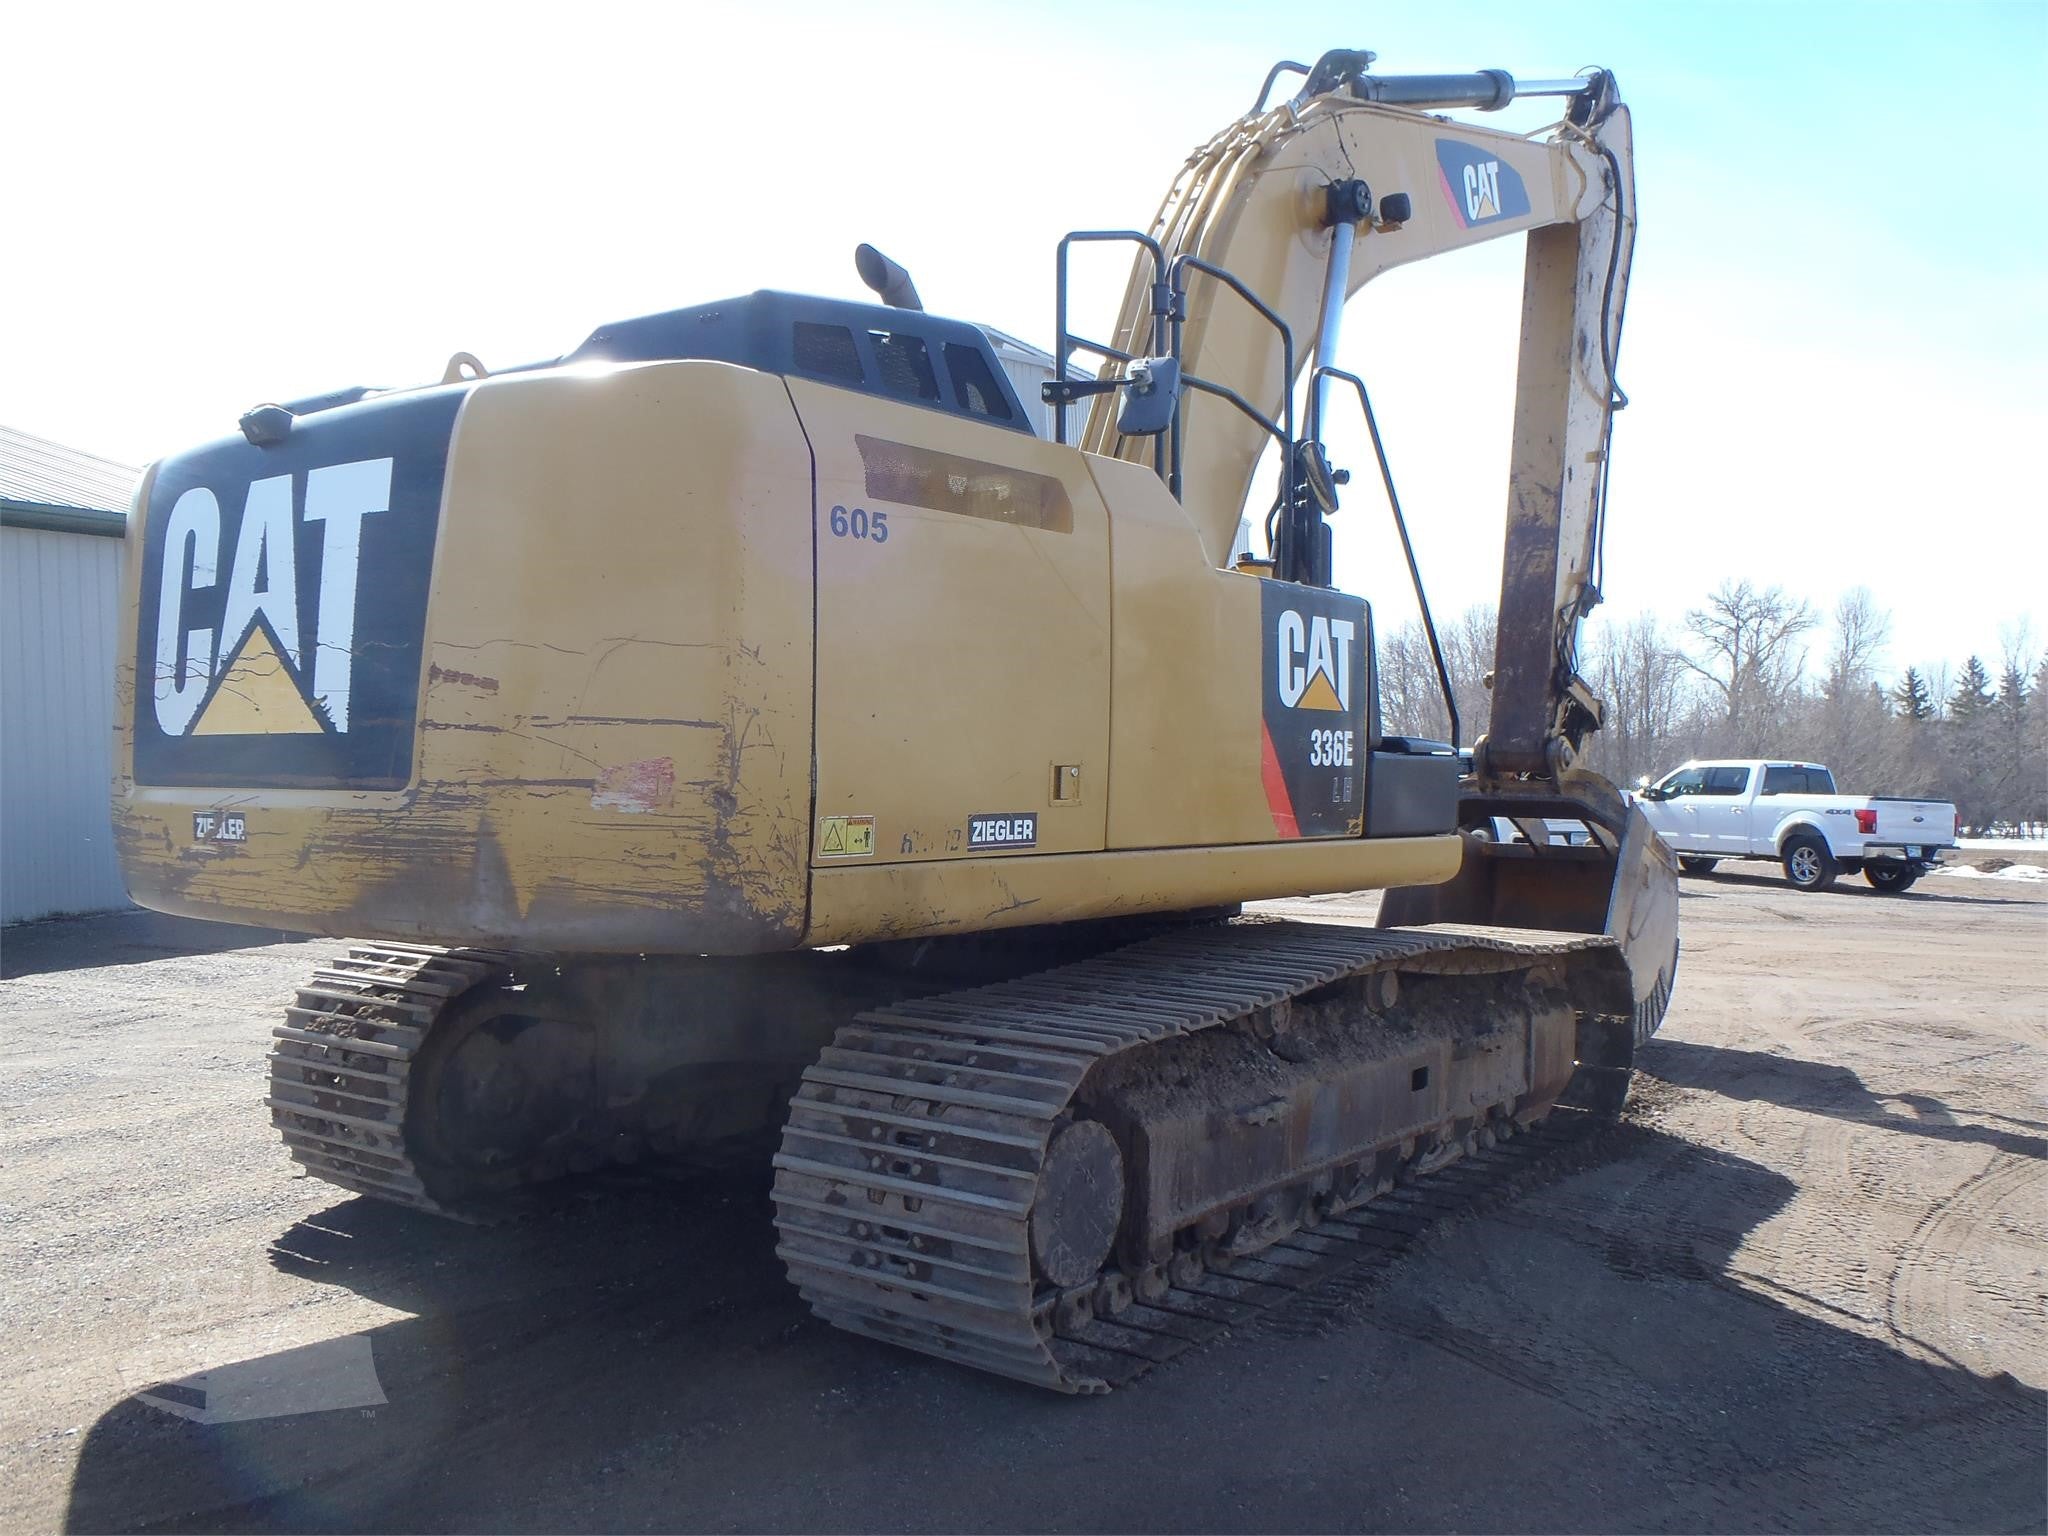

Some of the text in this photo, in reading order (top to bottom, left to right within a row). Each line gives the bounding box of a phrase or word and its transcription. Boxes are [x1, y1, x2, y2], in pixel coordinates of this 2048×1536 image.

[1463, 161, 1501, 220] CAT
[831, 505, 888, 543] 605
[154, 457, 393, 736] CAT
[1278, 610, 1354, 712] CAT
[1310, 729, 1353, 767] 336E
[972, 819, 1033, 842] ZIEGLER
